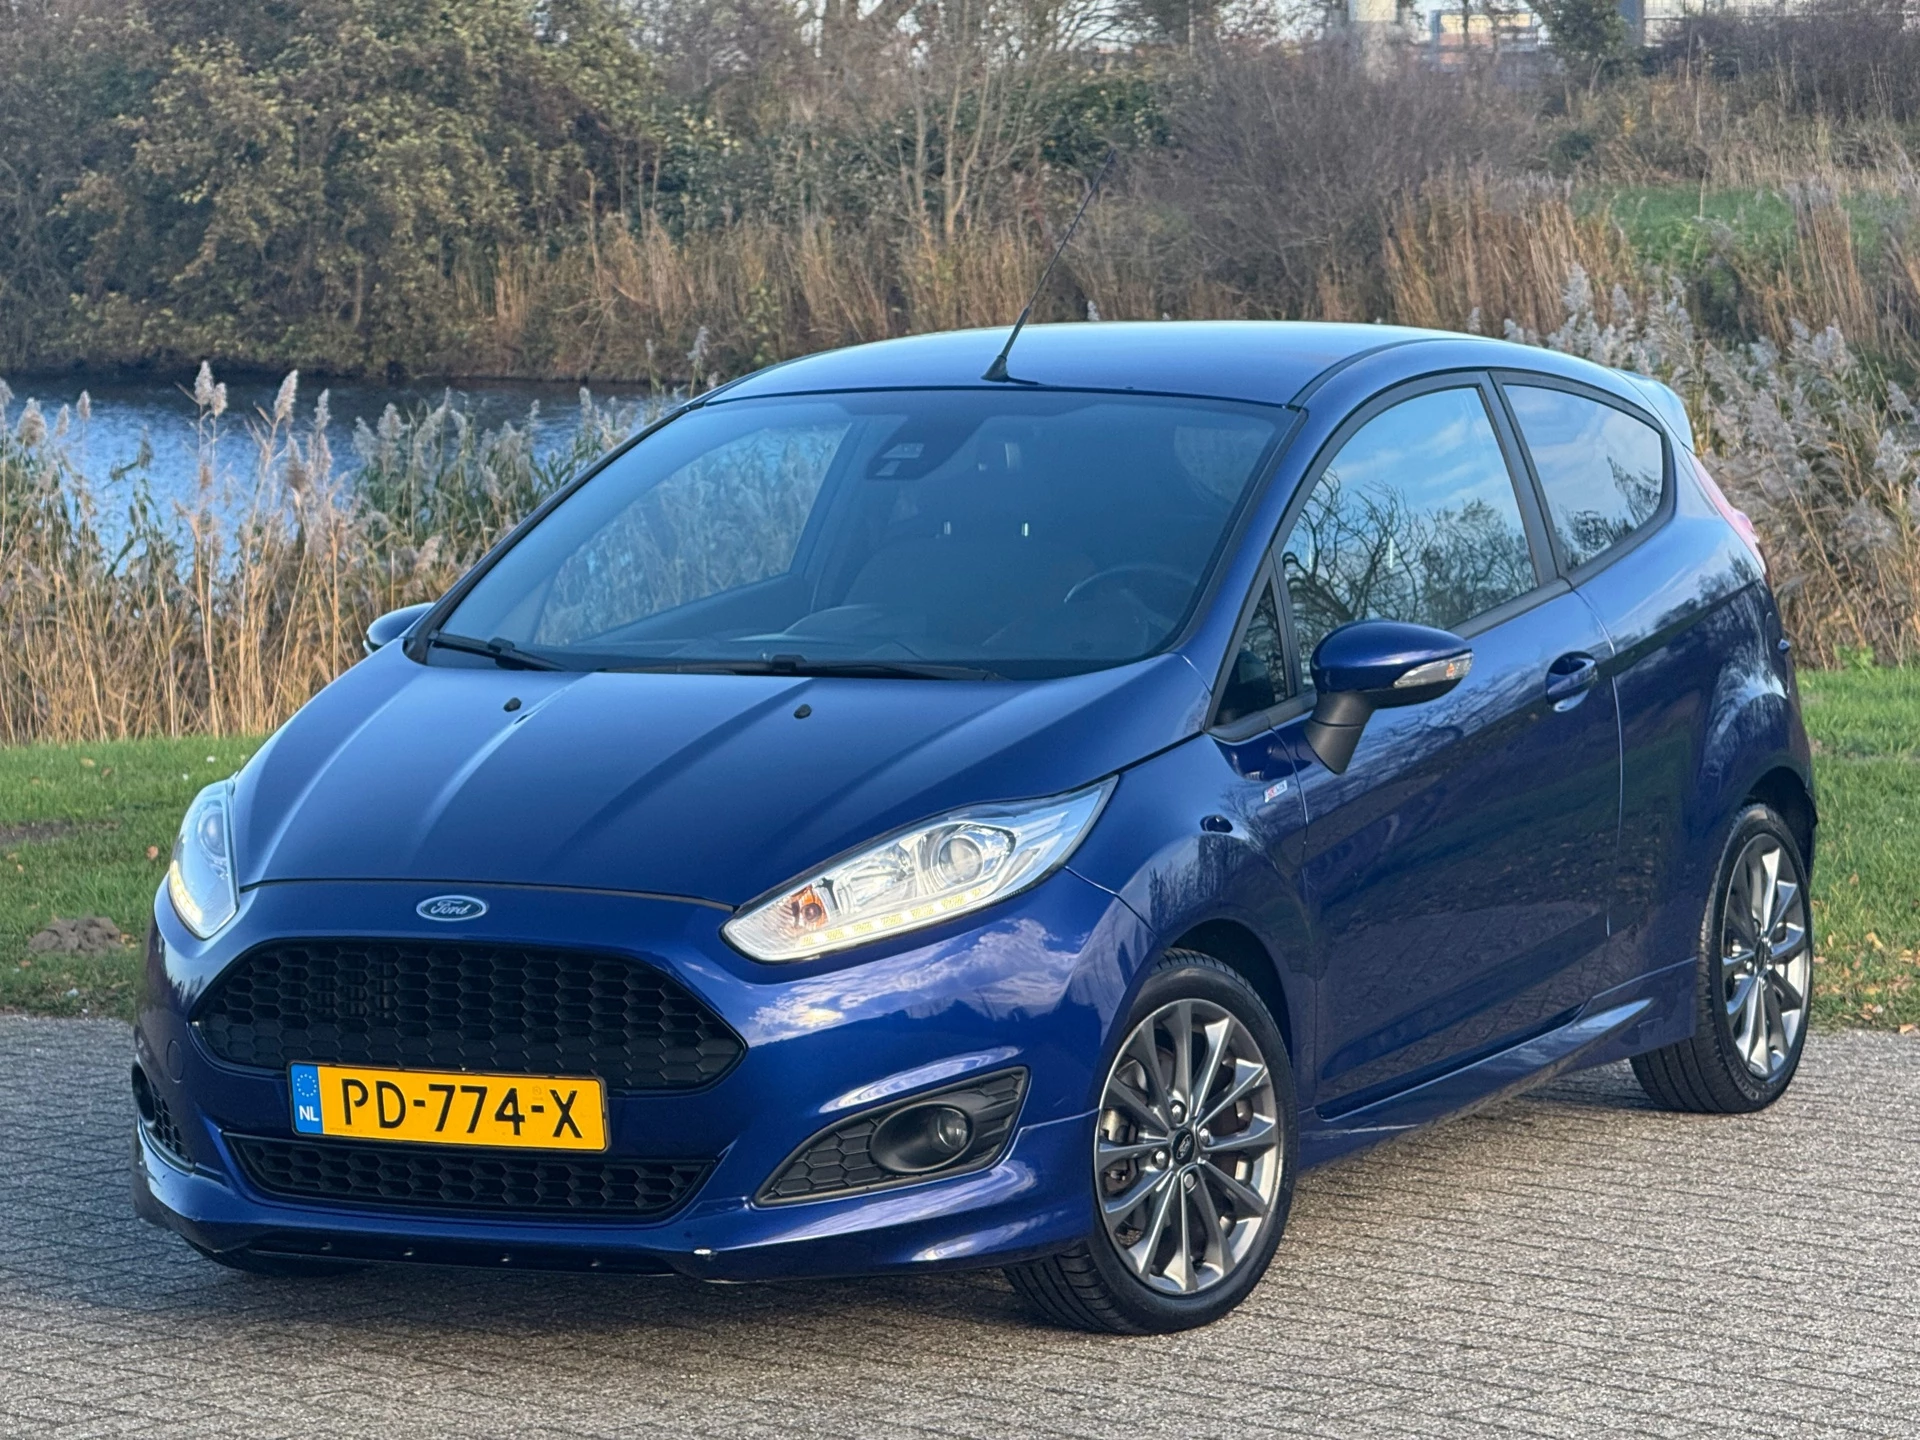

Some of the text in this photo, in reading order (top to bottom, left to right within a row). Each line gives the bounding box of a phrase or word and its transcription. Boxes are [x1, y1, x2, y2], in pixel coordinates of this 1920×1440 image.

[430, 900, 472, 915] Ford
[298, 1104, 320, 1122] NL
[341, 1078, 583, 1139] PD-774-X
